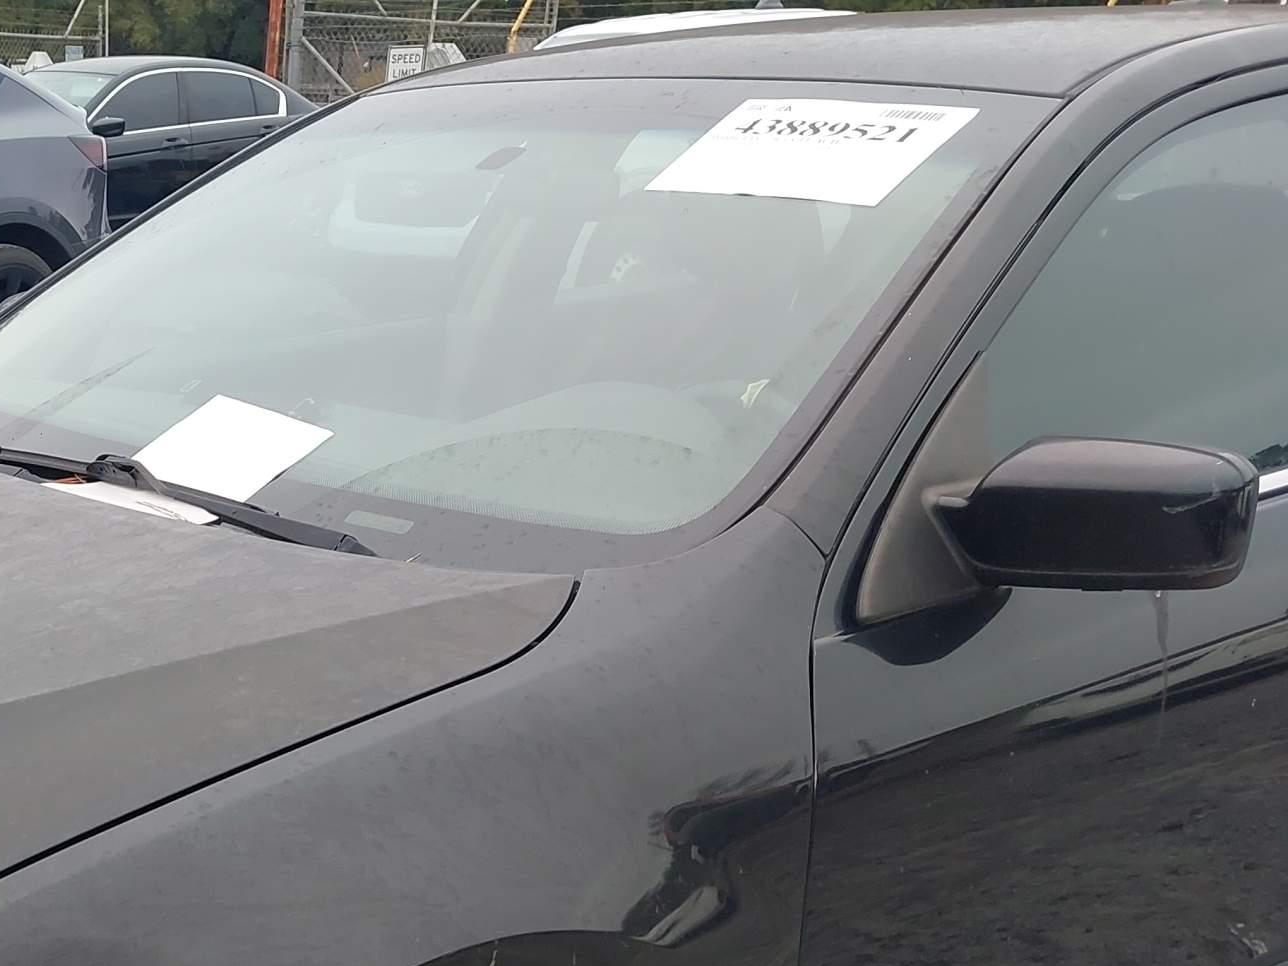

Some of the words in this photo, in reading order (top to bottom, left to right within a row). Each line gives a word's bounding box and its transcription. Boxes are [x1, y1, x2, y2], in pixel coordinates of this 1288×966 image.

[391, 54, 420, 63] SPEED
[392, 68, 416, 78] LIMIT
[735, 118, 918, 142] 43889521
